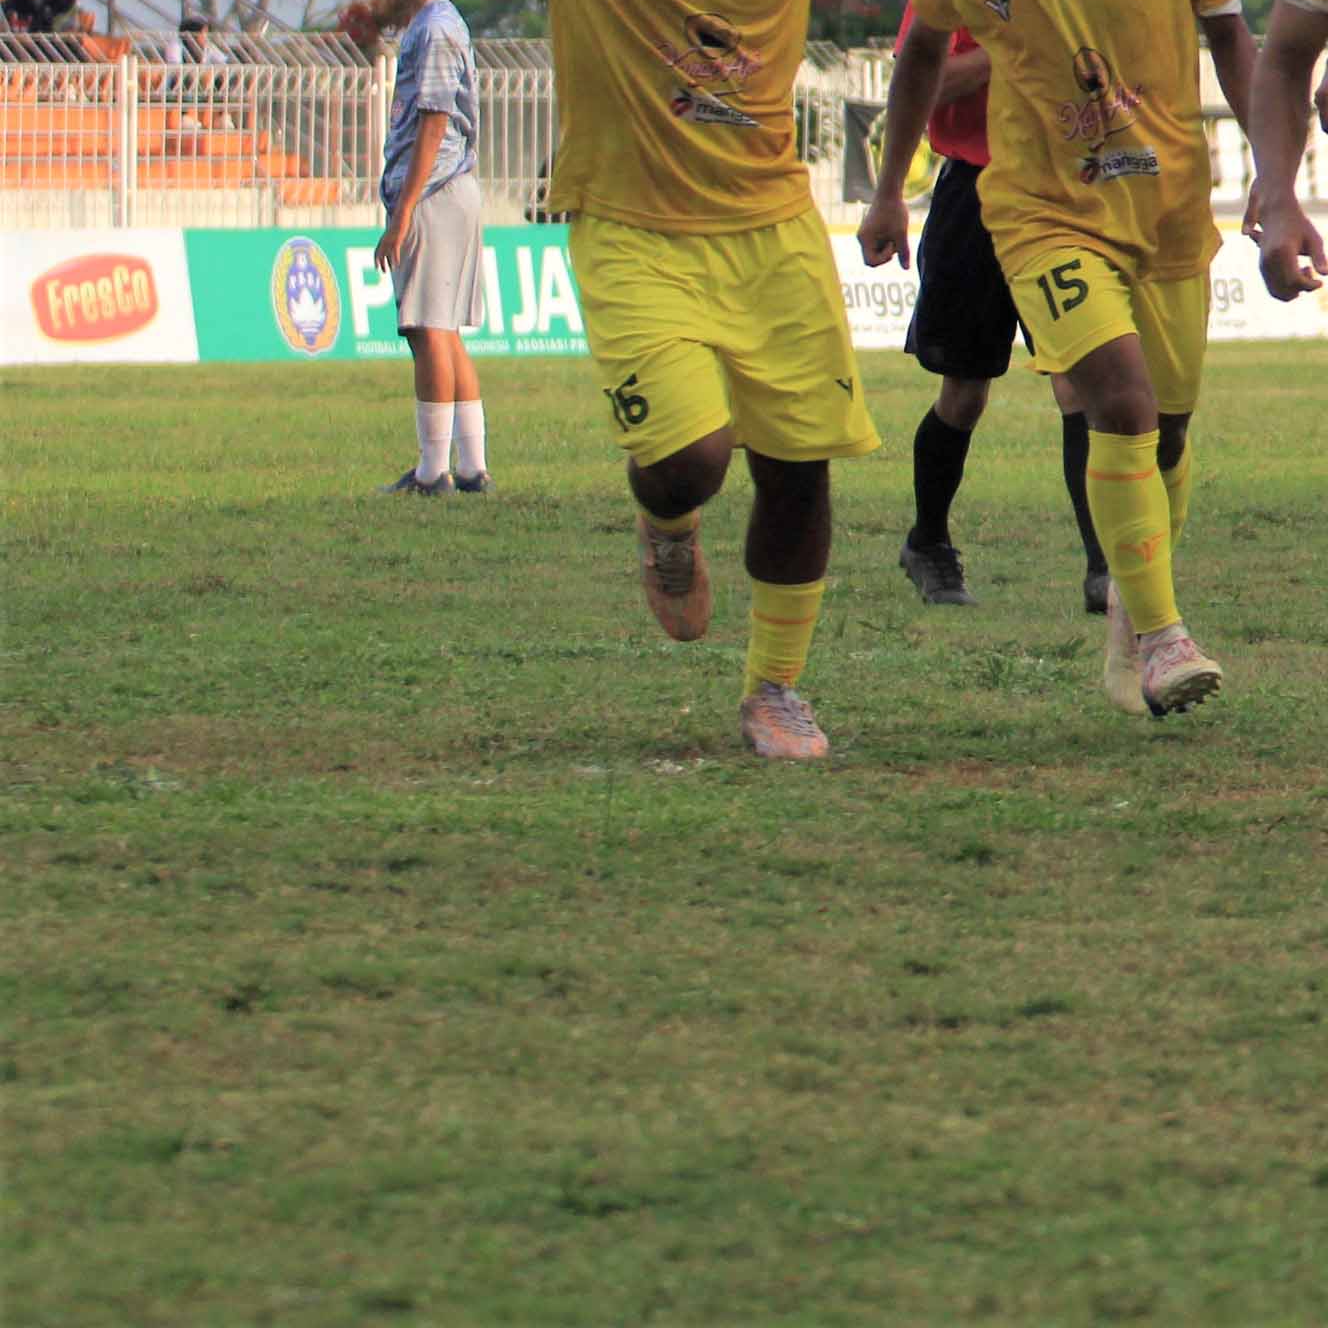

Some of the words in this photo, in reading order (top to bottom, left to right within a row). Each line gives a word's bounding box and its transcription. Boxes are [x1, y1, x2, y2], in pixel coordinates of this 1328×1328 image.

[511, 246, 585, 335] JA
[841, 281, 918, 317] angga
[1037, 258, 1089, 321] 15
